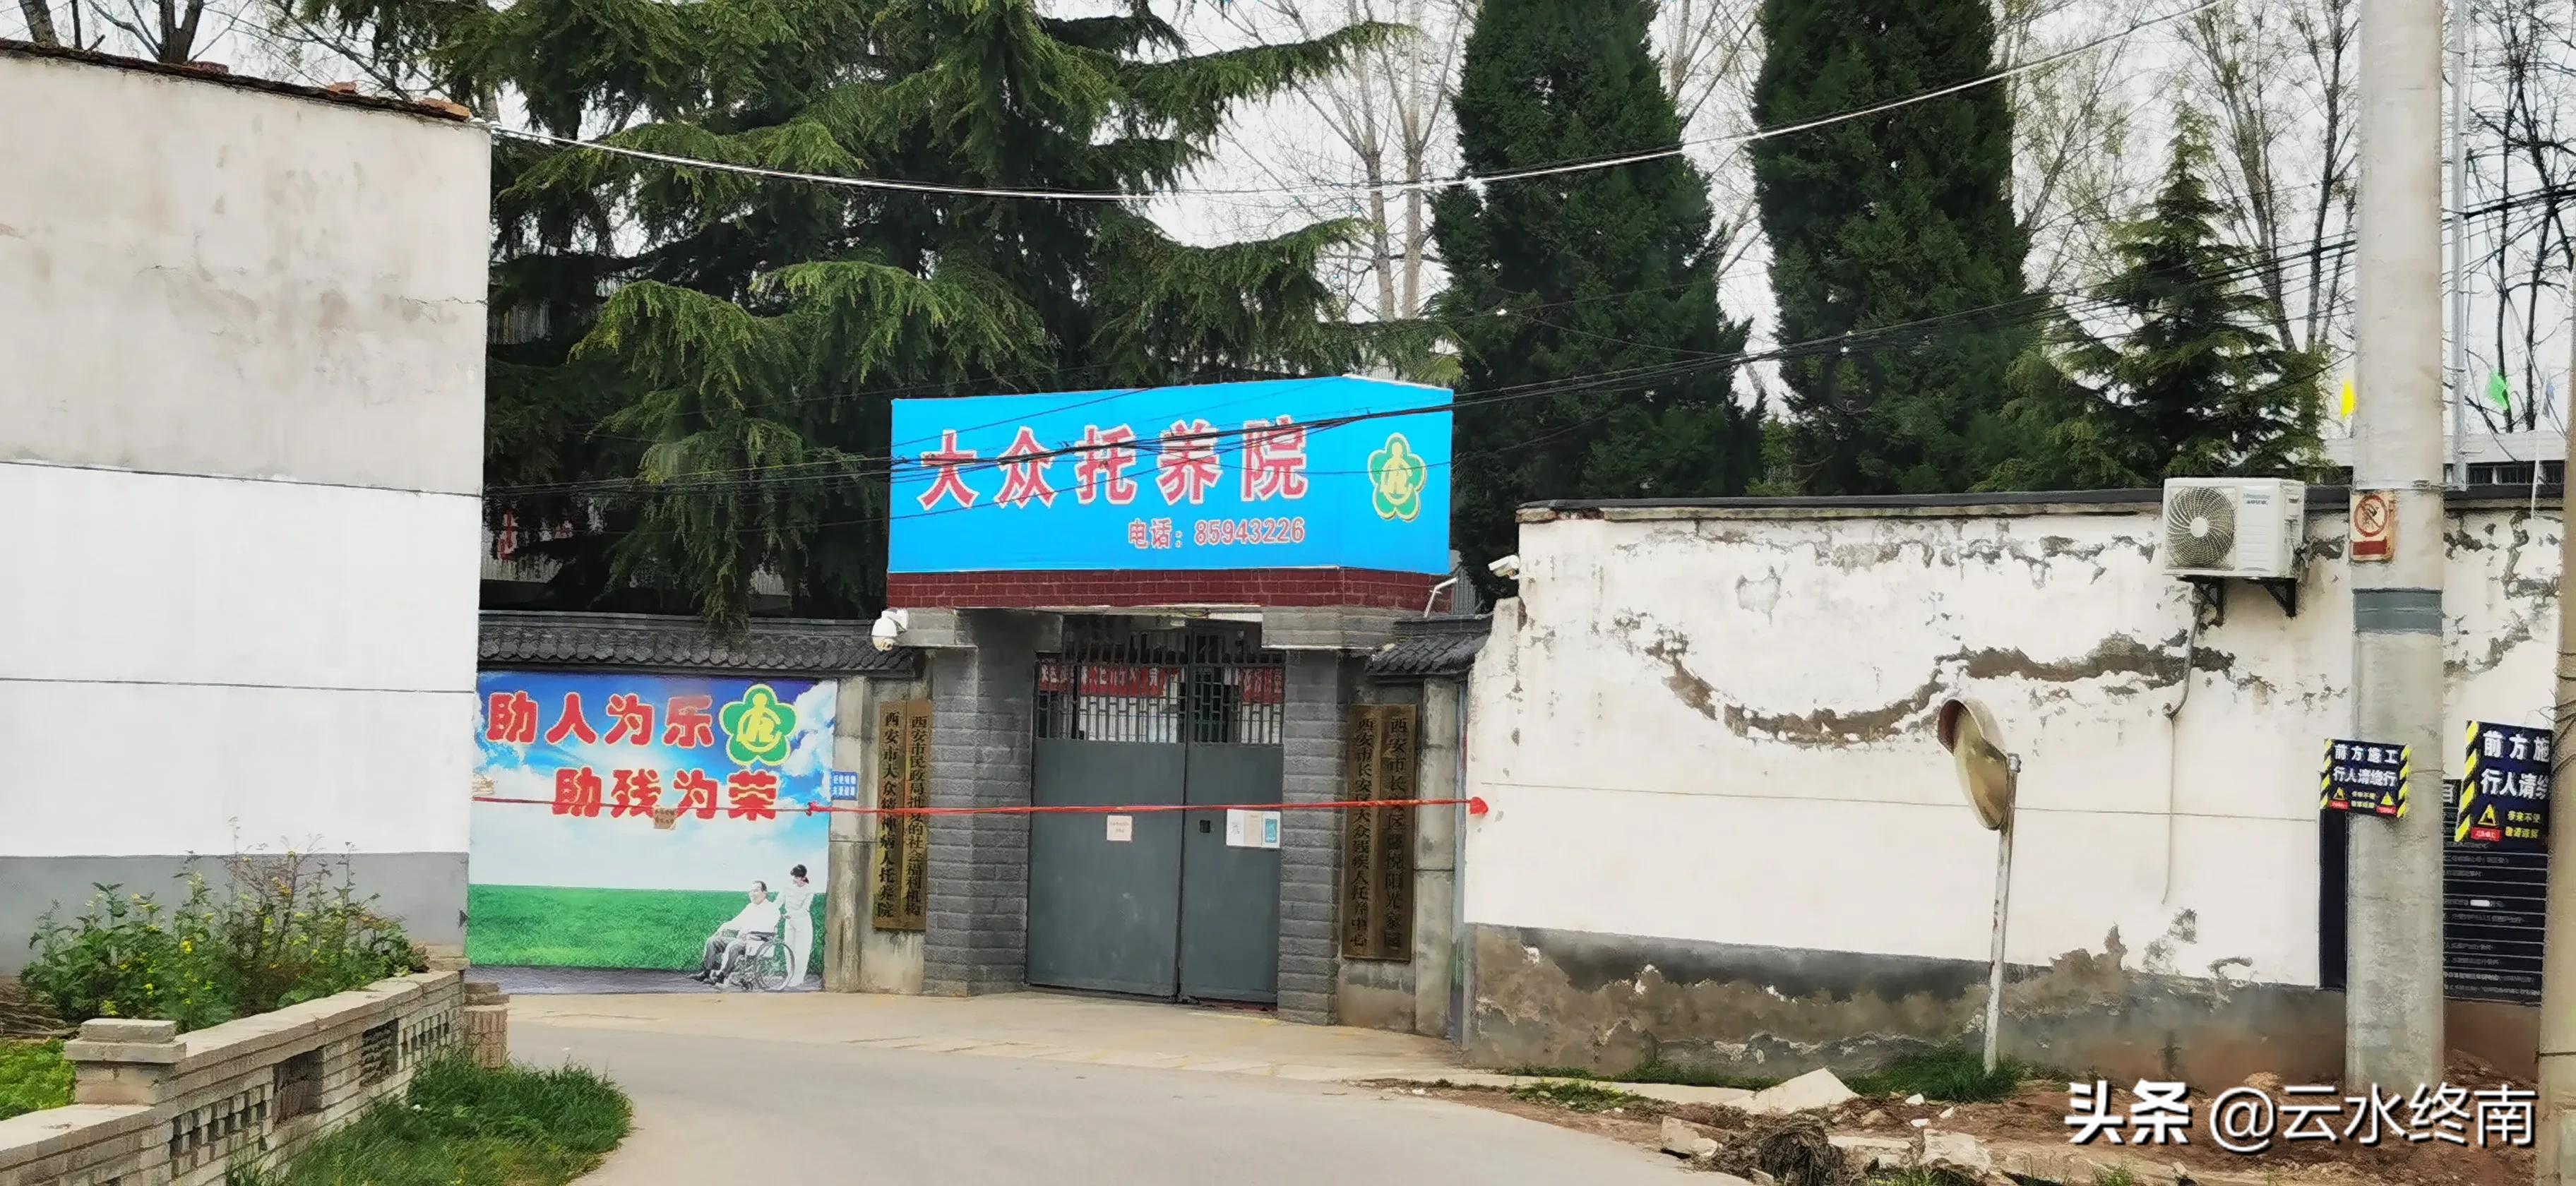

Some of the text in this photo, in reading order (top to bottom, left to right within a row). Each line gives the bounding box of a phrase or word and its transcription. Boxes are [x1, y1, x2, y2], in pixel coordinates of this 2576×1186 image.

[917, 414, 1310, 510] 大众托养院
[486, 690, 715, 748] 助人为乐
[2332, 765, 2397, 787] 行人请绕行
[2334, 743, 2399, 765] 前方施工
[551, 767, 779, 822] 助残为荣
